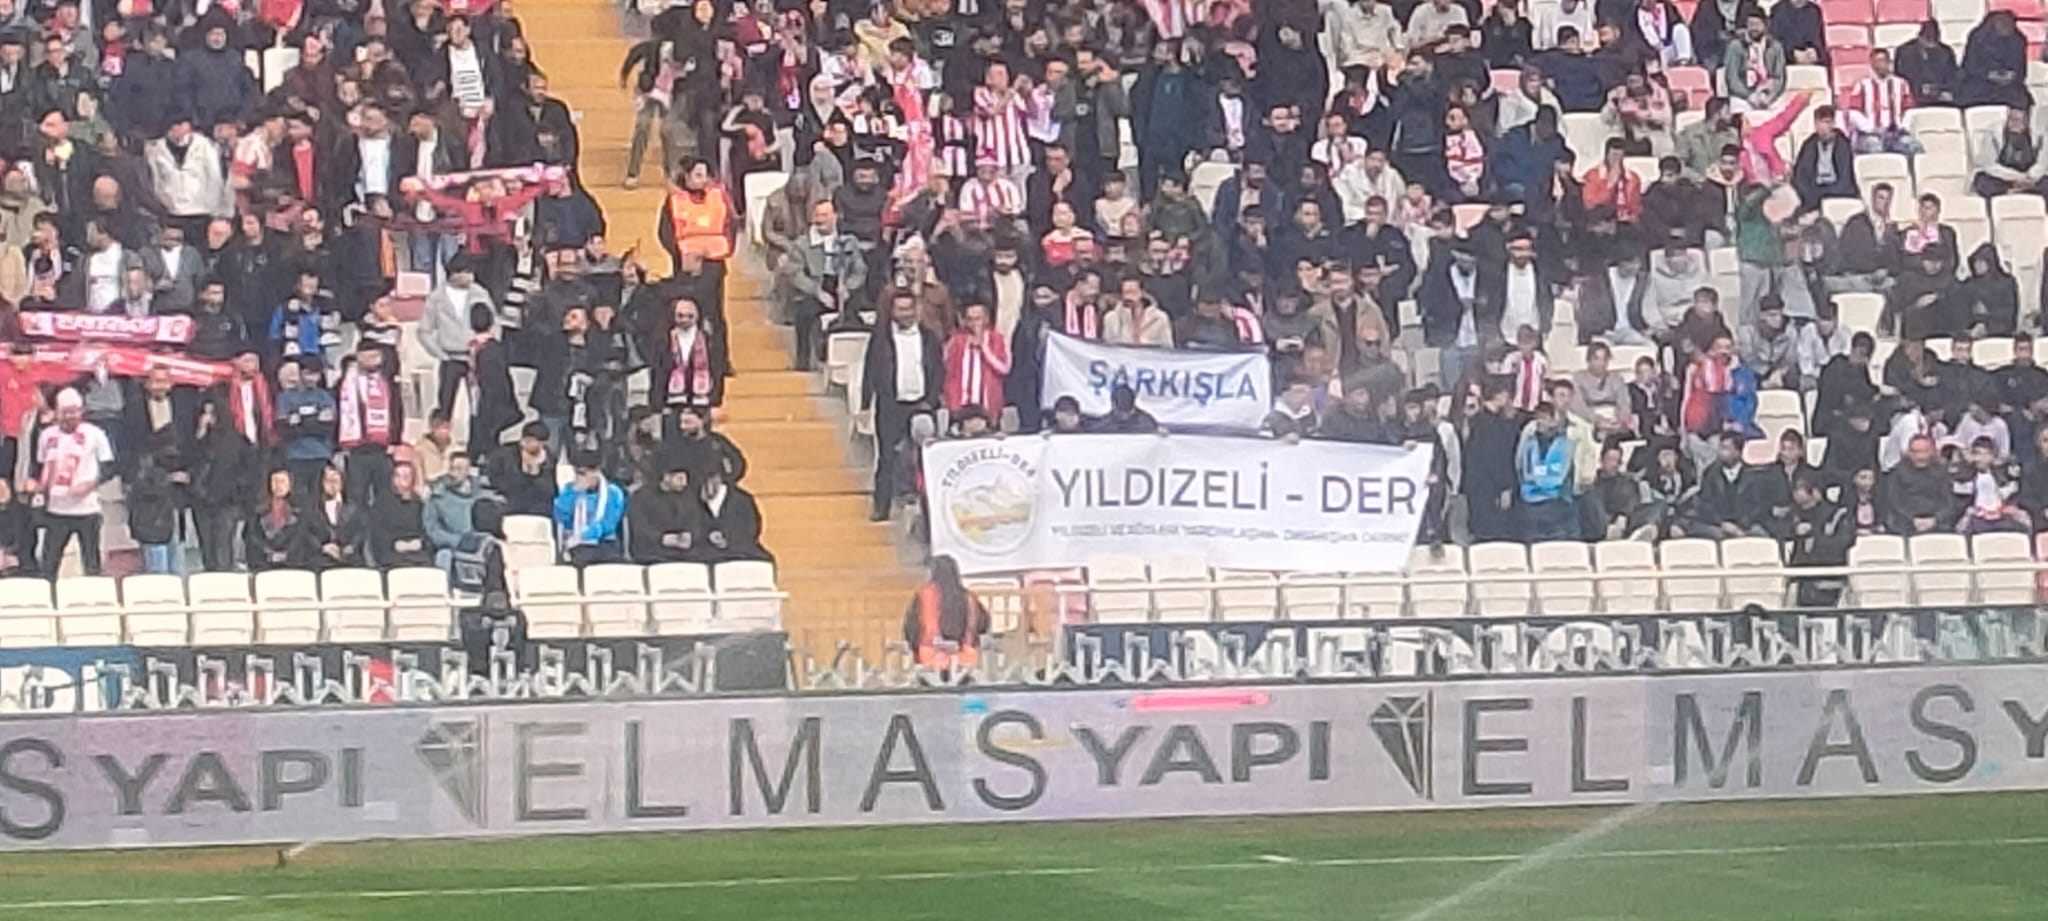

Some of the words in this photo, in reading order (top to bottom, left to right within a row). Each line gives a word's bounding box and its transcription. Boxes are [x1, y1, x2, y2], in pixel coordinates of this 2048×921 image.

[1087, 360, 1258, 406] ŞARKIŞLA
[1051, 461, 1268, 511] YILDIZELİ
[1320, 475, 1417, 515] DER
[94, 746, 364, 816] YAPI
[513, 709, 1048, 822] ELMAS
[1070, 720, 1331, 787] YAPI
[1461, 684, 1977, 796] ELMAS
